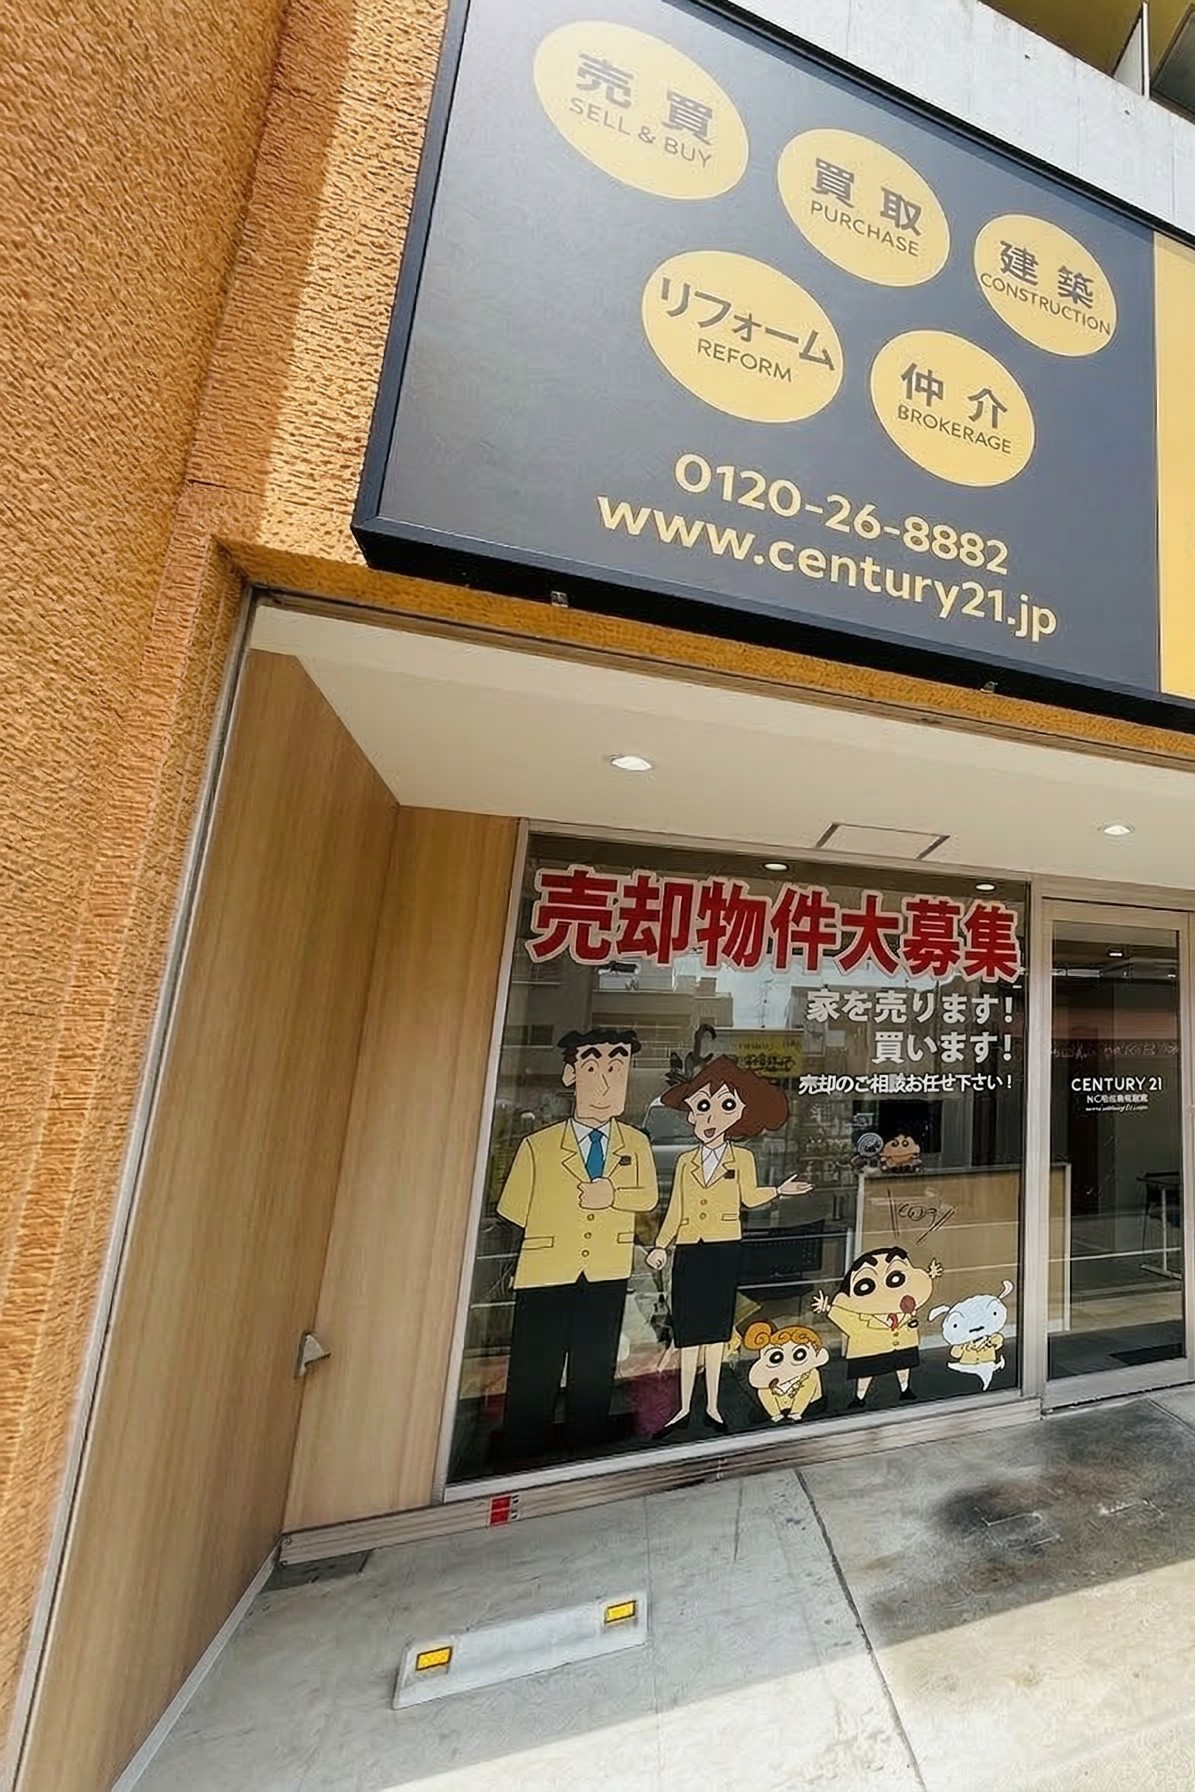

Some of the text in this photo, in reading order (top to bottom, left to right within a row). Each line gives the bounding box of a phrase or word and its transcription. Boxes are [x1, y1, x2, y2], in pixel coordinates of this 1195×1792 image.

[568, 97, 713, 168] SELL & BUY
[810, 200, 920, 257] PURCHASE
[811, 157, 923, 236] 買取
[980, 272, 1112, 336] CONSTRUCTION
[999, 241, 1094, 309] 建築
[660, 277, 836, 371] リフォーム
[697, 338, 793, 382] REFORM
[901, 363, 1008, 429] 仲介
[898, 405, 1012, 454] BROKERAGE
[674, 454, 1009, 575] 0120-26-8882
[598, 496, 1058, 642] www.century21.jp
[527, 866, 1021, 982] 売却物件大募集
[806, 988, 1014, 1026] 家を売ります!
[872, 1030, 1013, 1065] 買います!
[1071, 1076, 1163, 1092] CENTURY 21
